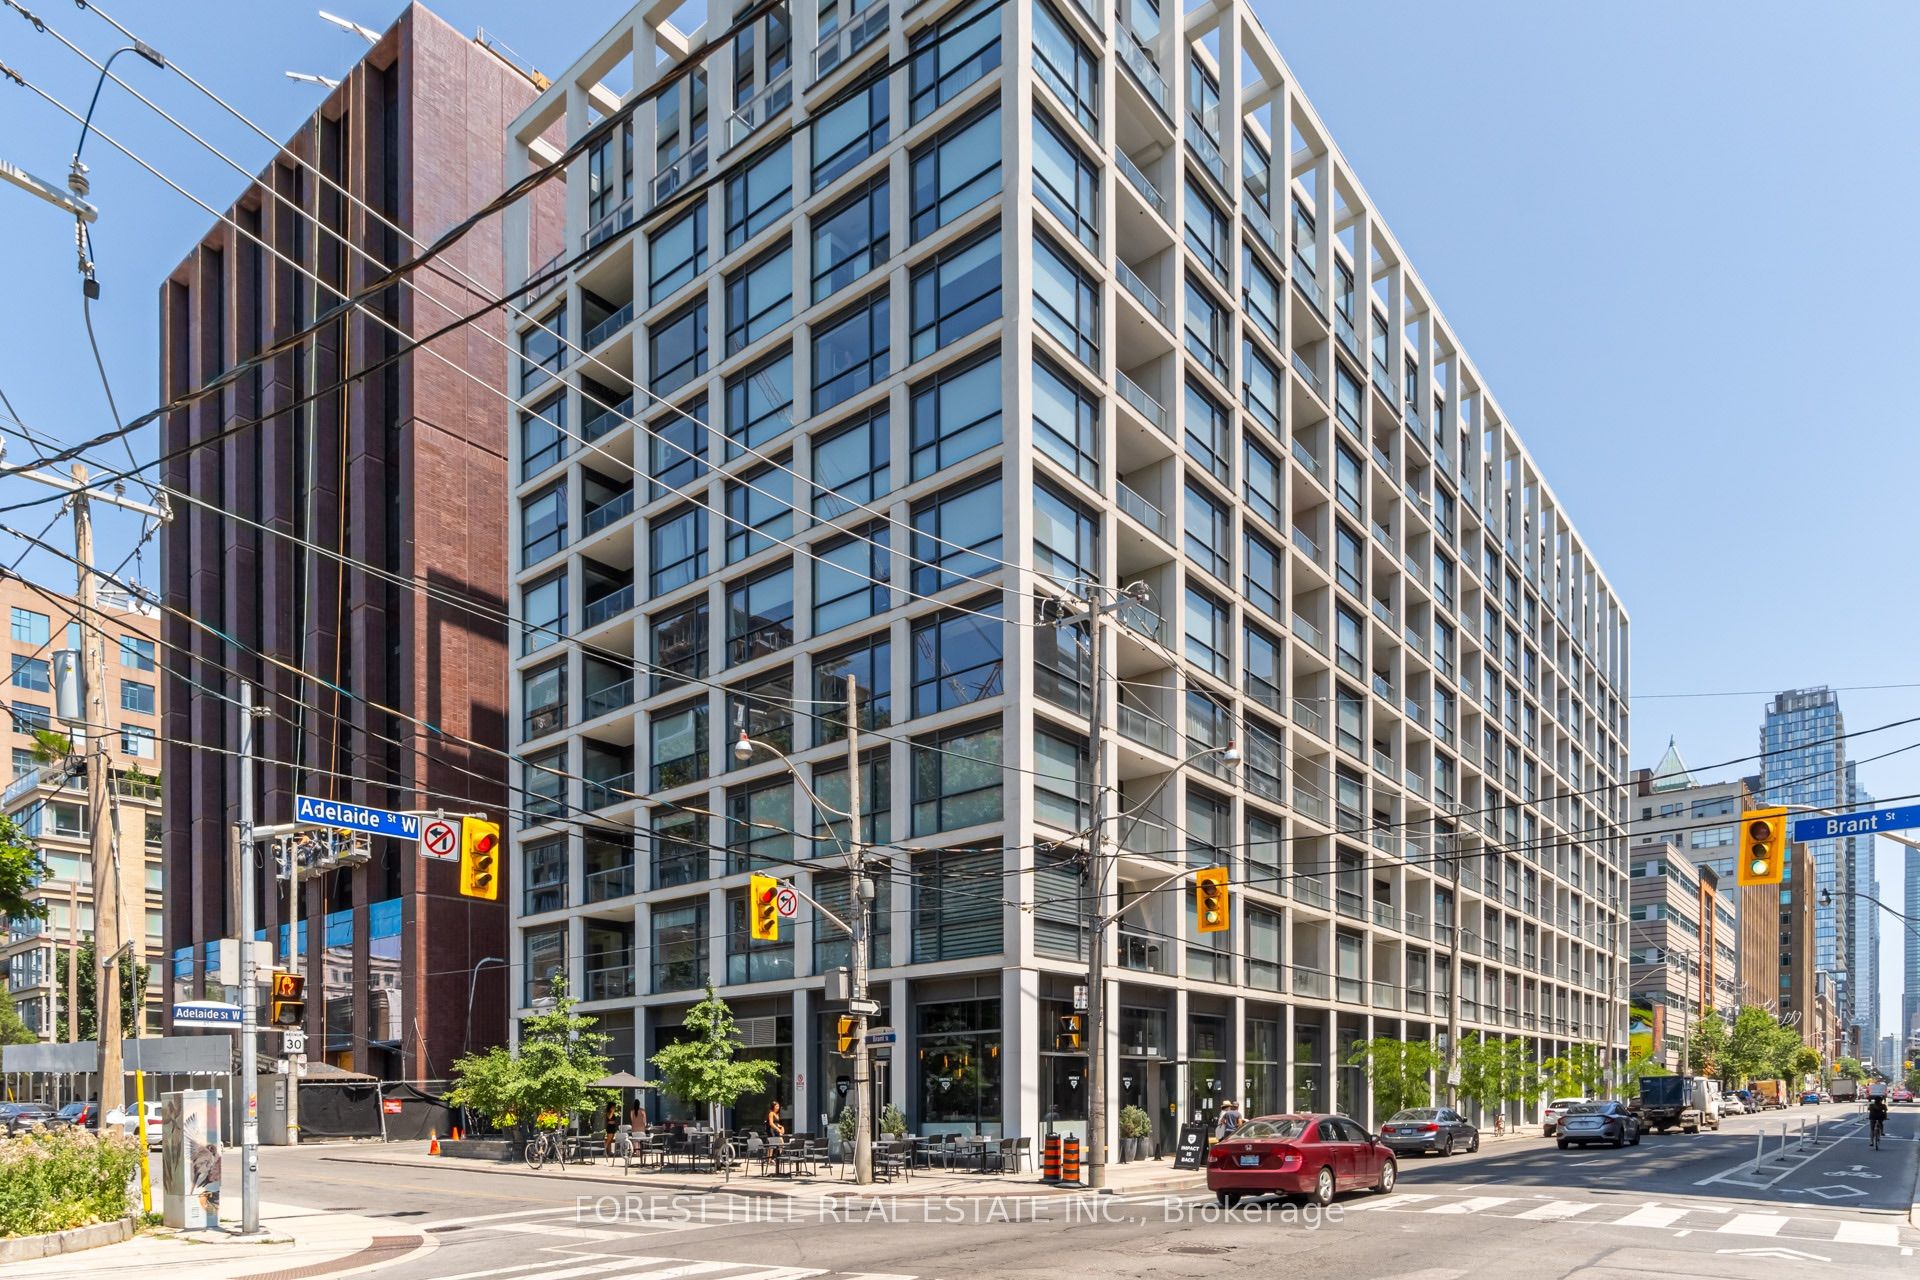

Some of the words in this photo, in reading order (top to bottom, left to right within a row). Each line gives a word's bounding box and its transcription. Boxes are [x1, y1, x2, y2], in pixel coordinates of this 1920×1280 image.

[300, 799, 380, 827] Adelaide
[387, 814, 396, 824] St
[402, 816, 416, 834] W
[1826, 815, 1878, 835] Brant
[1885, 812, 1896, 821] St
[176, 1008, 219, 1019] Adelaide
[220, 1011, 228, 1020] St
[232, 1010, 240, 1020] W
[286, 1039, 302, 1050] 30
